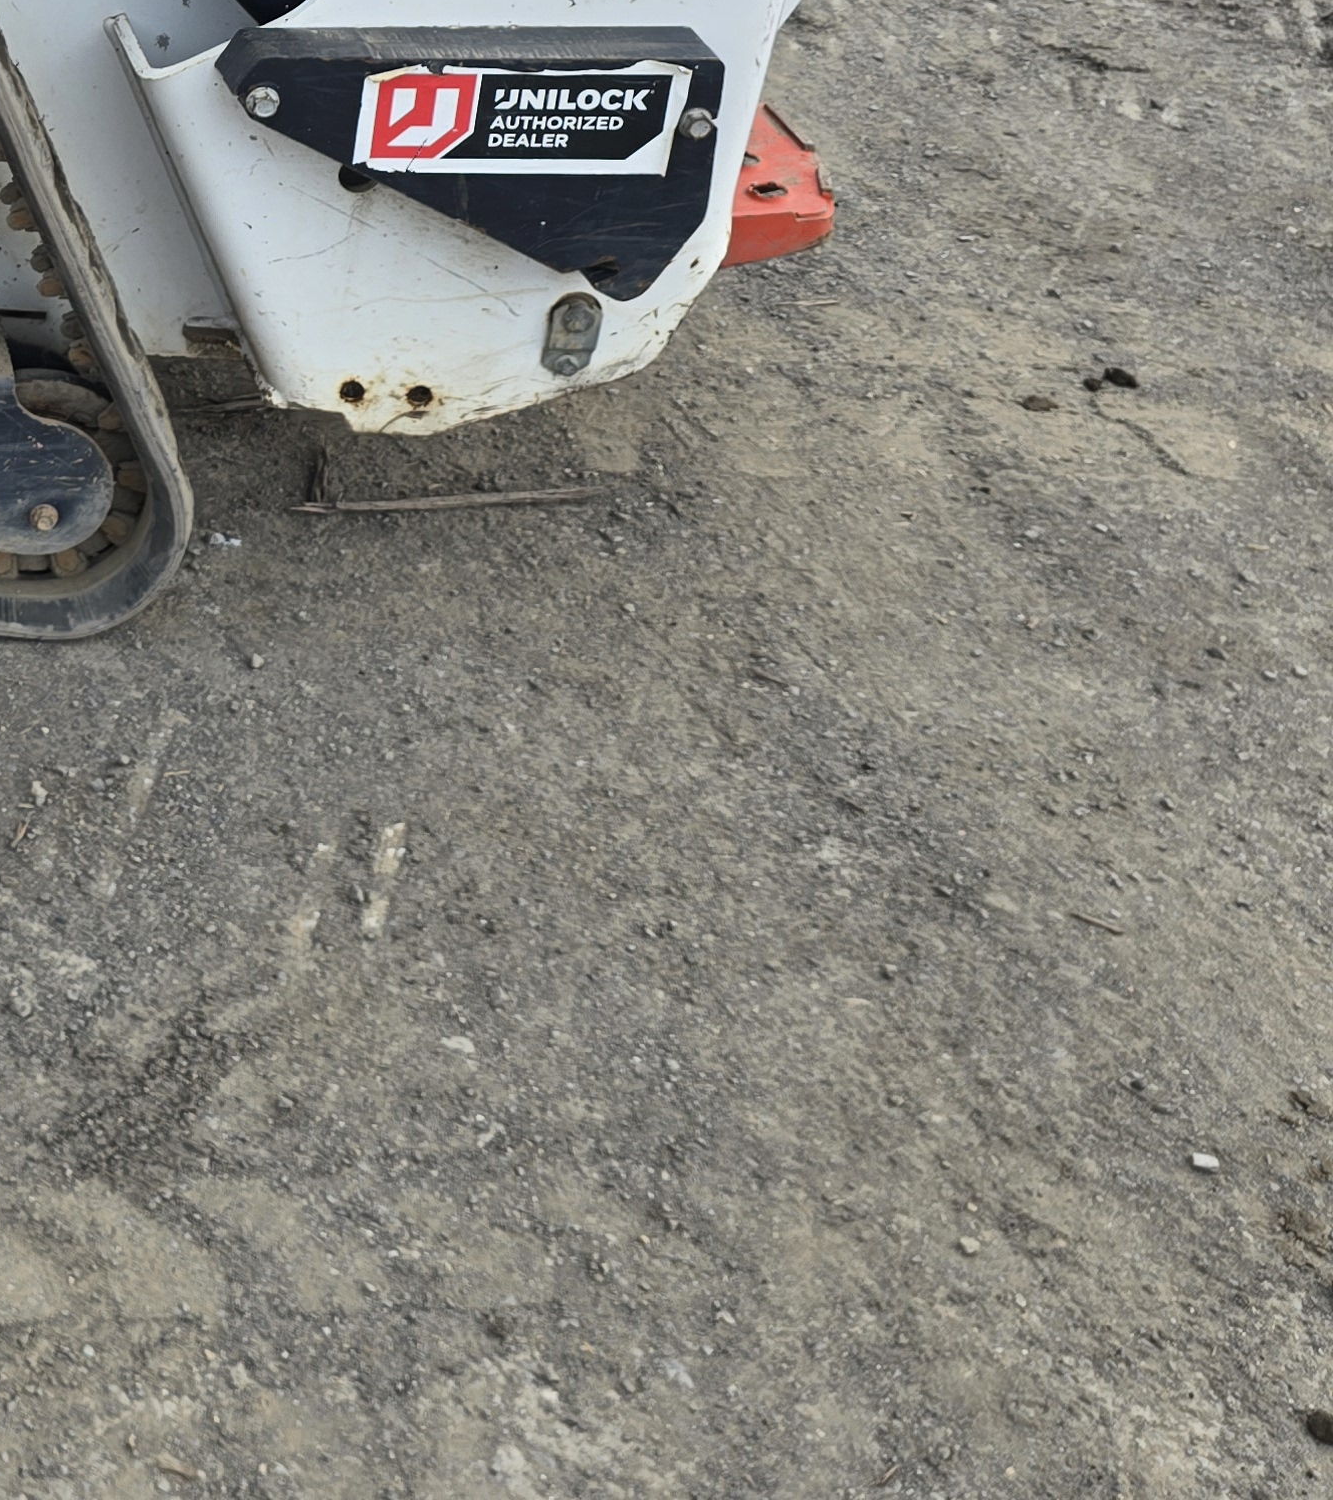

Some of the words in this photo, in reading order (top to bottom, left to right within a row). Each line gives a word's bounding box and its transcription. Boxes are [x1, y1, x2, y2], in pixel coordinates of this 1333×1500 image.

[494, 88, 650, 111] UNILOCK
[489, 115, 624, 131] AUTHORIZED
[487, 133, 570, 149] DEALER
